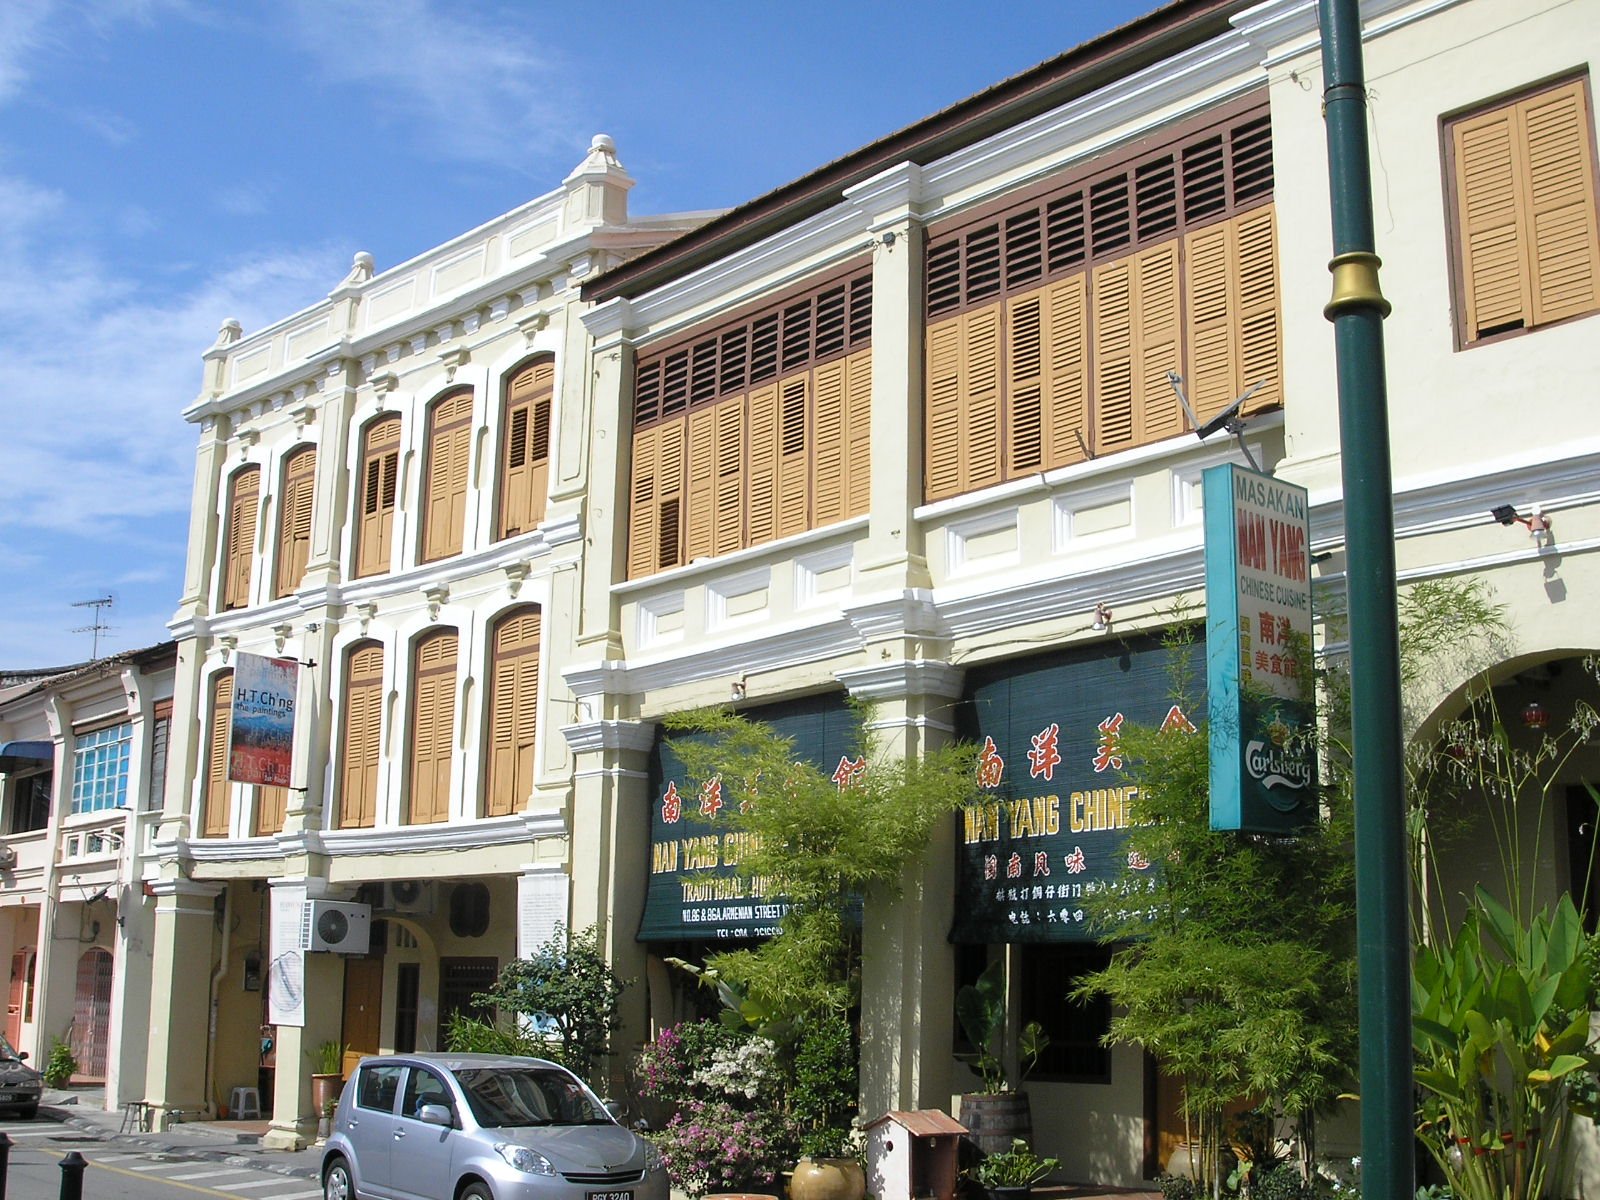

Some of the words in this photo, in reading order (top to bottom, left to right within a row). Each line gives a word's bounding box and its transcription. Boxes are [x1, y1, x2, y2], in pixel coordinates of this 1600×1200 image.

[1236, 475, 1304, 520] MASAKAN
[1237, 507, 1267, 572] NAN
[1269, 518, 1306, 584] YANG
[1240, 575, 1275, 602] CHINESE
[1276, 586, 1307, 611] CUISINE
[252, 704, 286, 720] paintings
[1245, 739, 1311, 787] Carlsberg
[964, 803, 1001, 845] NAN
[1010, 793, 1060, 839] YANG
[652, 840, 679, 875] NAN
[681, 834, 719, 871] YANG
